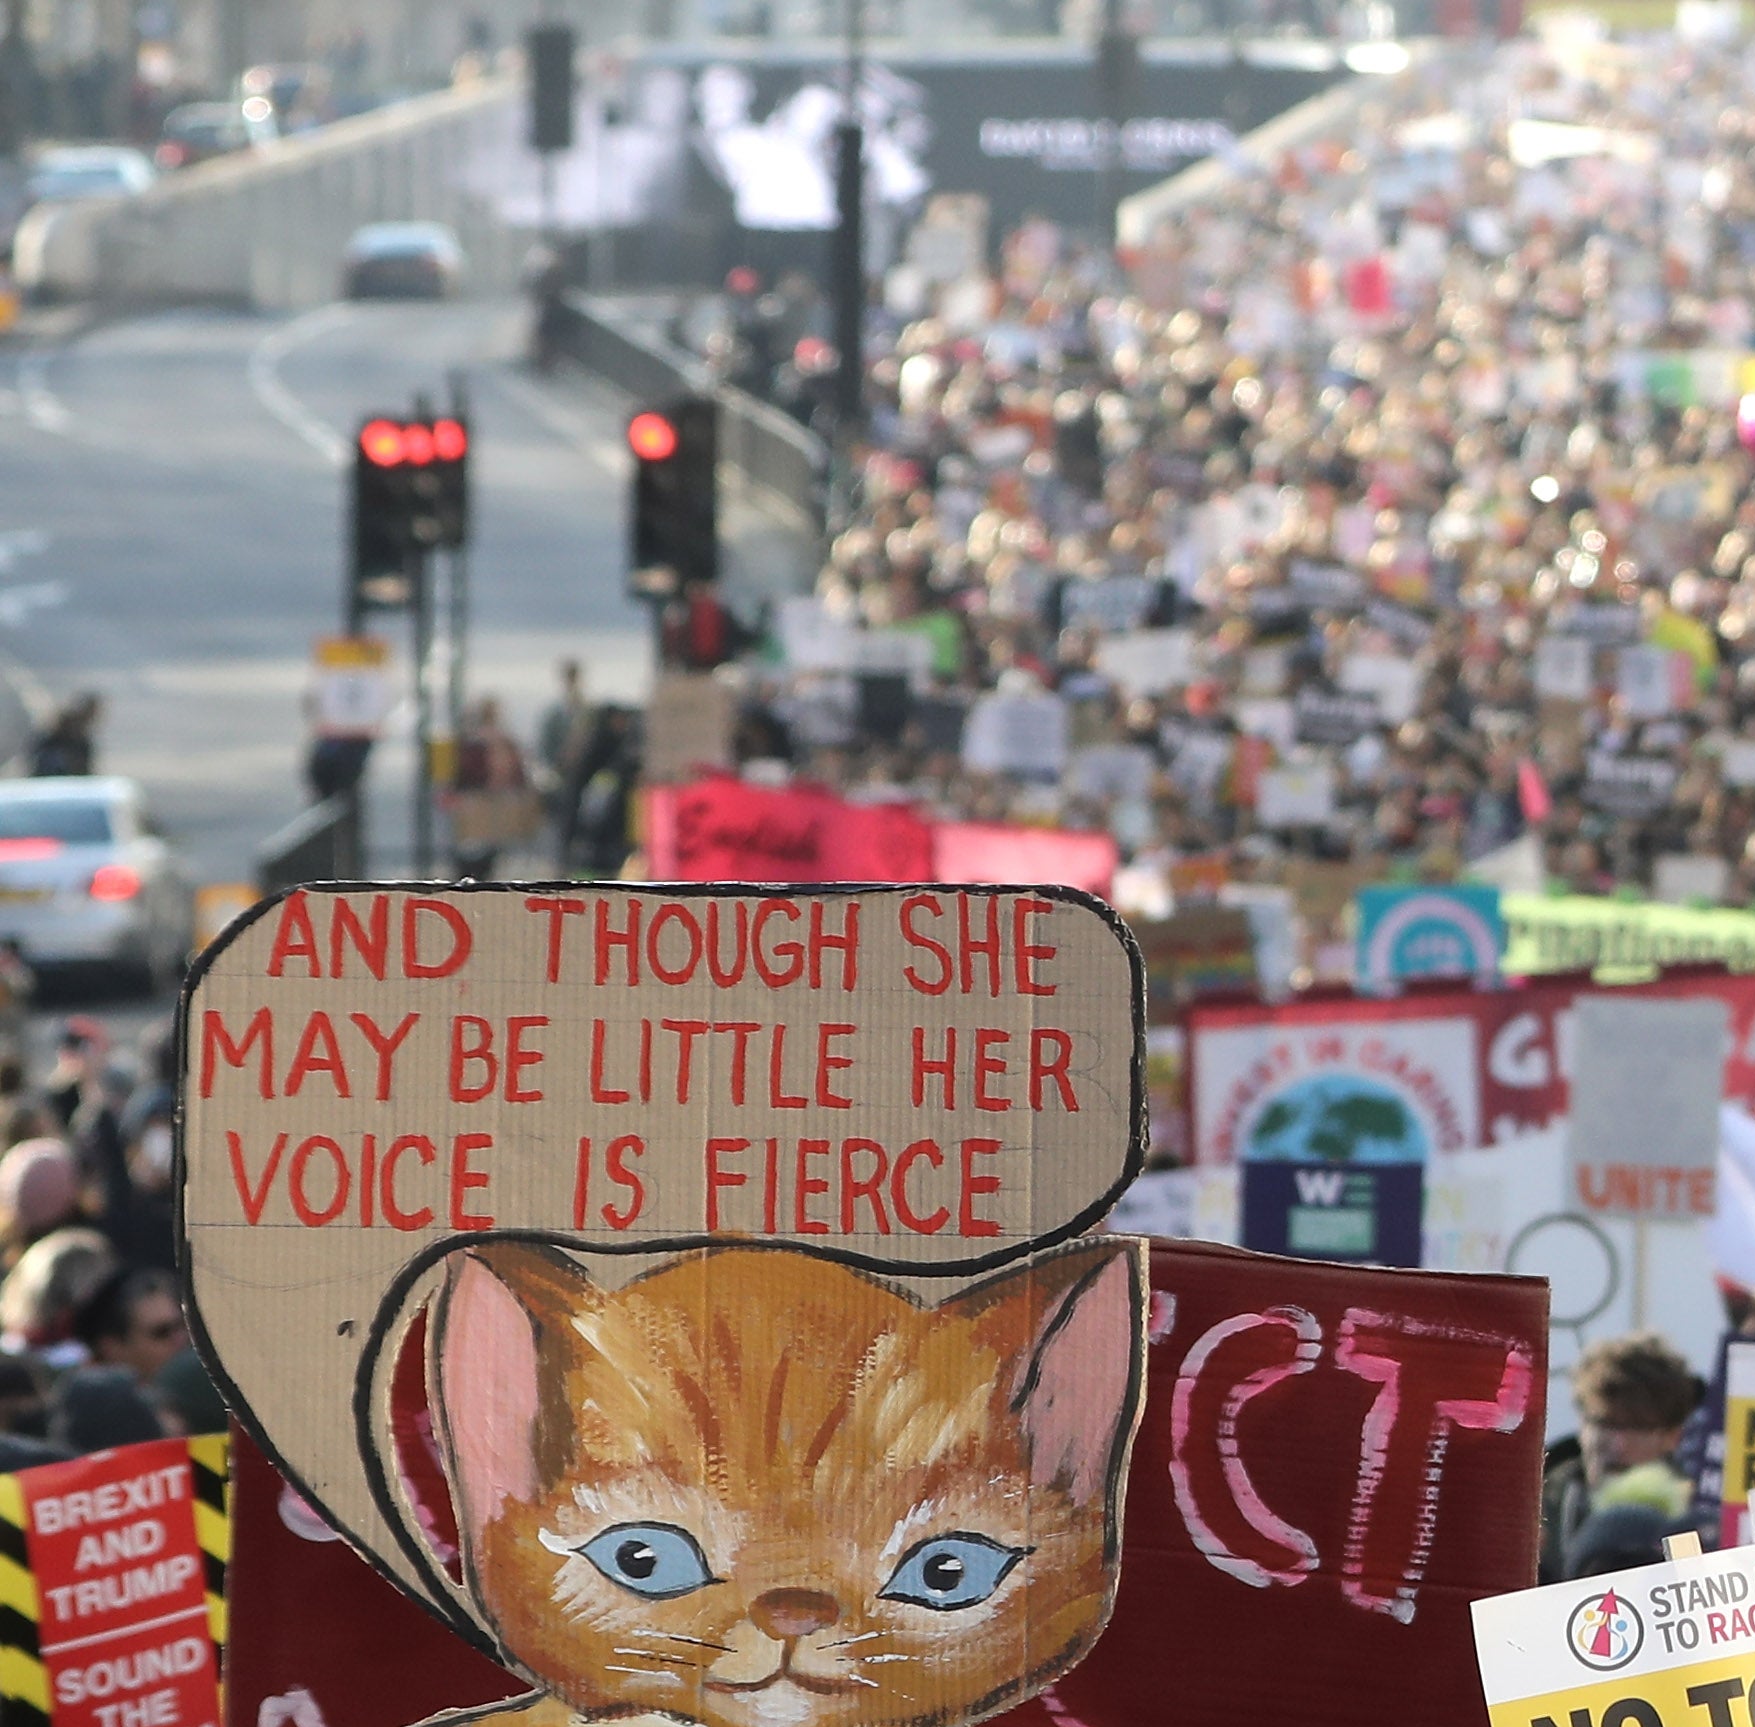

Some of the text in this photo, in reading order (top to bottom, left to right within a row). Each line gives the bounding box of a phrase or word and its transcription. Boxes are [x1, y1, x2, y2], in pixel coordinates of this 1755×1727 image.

[269, 891, 1056, 997] AND THOUGH SHE
[202, 1007, 1080, 1112] MAY BE LITTLE HER
[226, 1130, 1004, 1237] VOICE IS FIERCE
[1576, 1163, 1716, 1215] UNITE
[33, 1464, 192, 1536] BREXIT
[74, 1520, 166, 1572] AND
[45, 1554, 198, 1622] TRUMP
[1649, 1569, 1748, 1618] STAND
[54, 1637, 207, 1704] SOUND
[1655, 1620, 1701, 1654] TO
